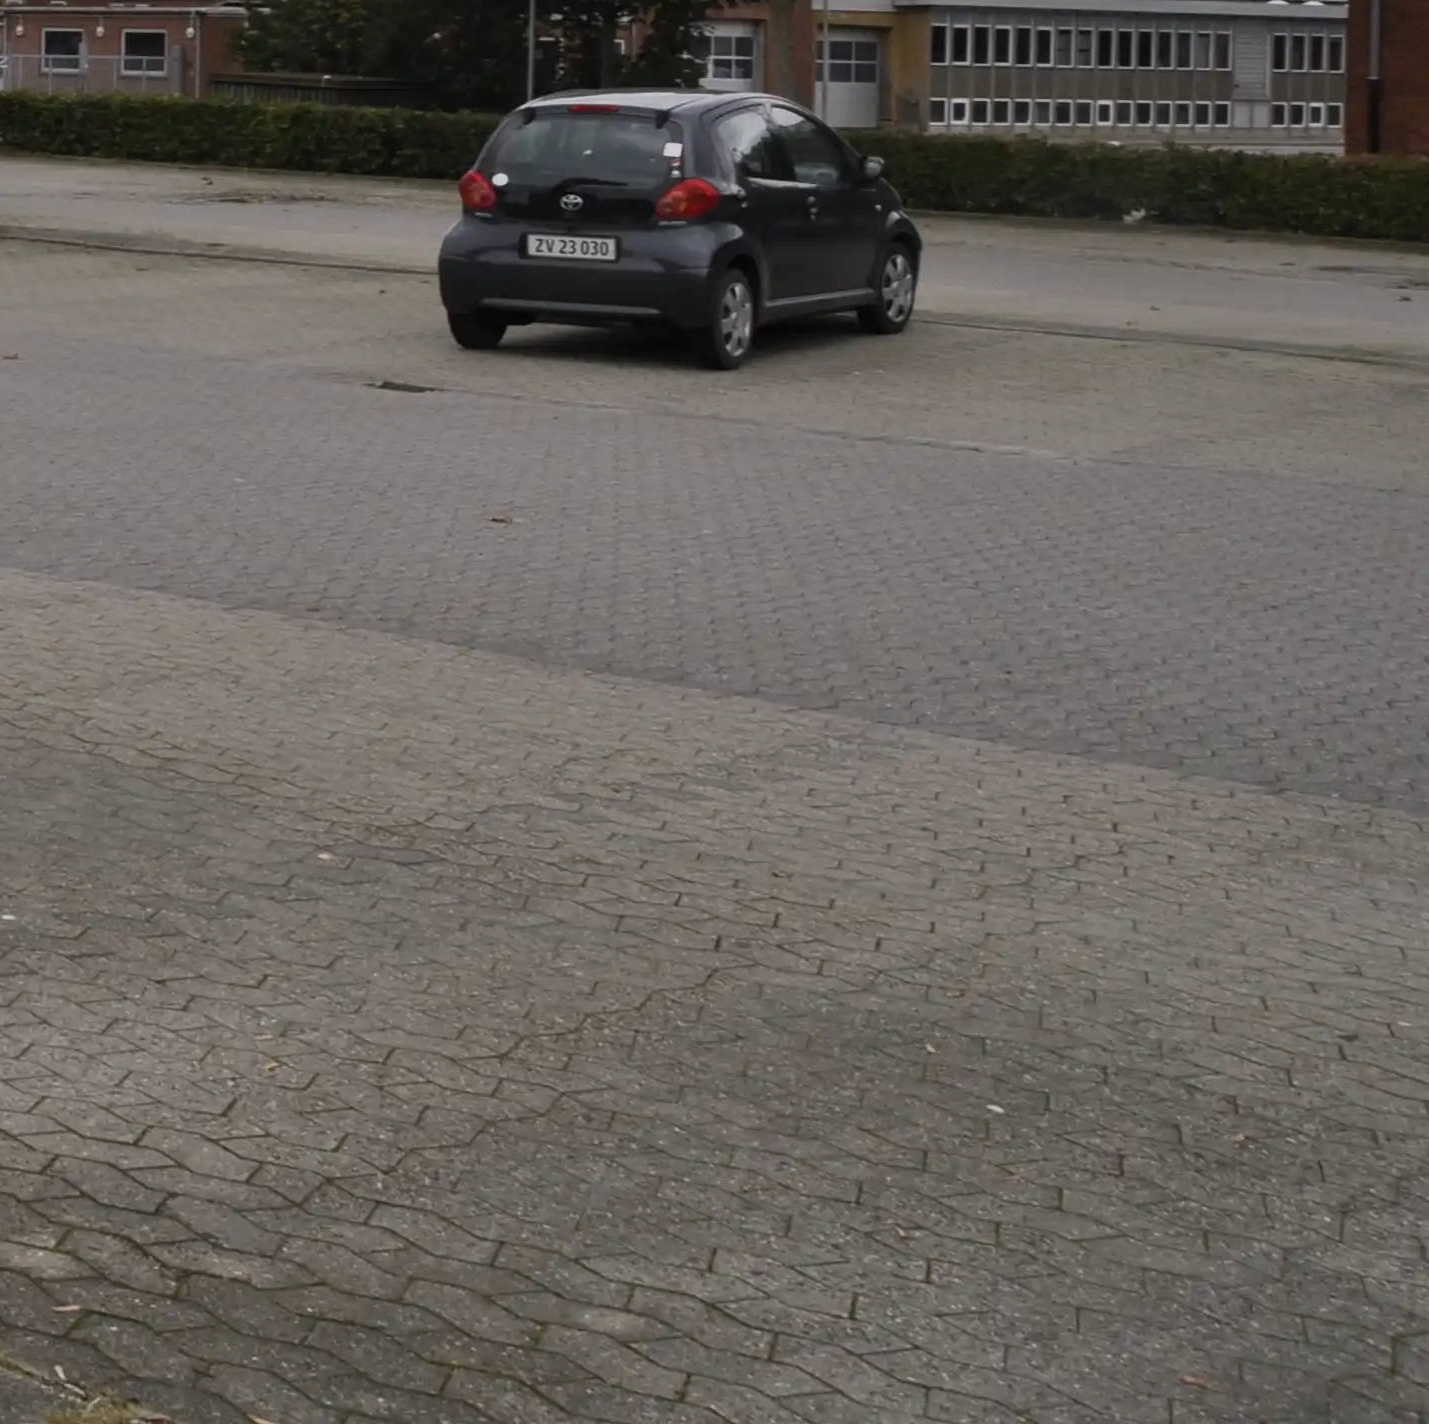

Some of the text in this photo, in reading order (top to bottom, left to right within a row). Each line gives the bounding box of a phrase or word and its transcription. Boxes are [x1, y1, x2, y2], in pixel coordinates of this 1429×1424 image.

[534, 238, 609, 256] ZV 23 030
